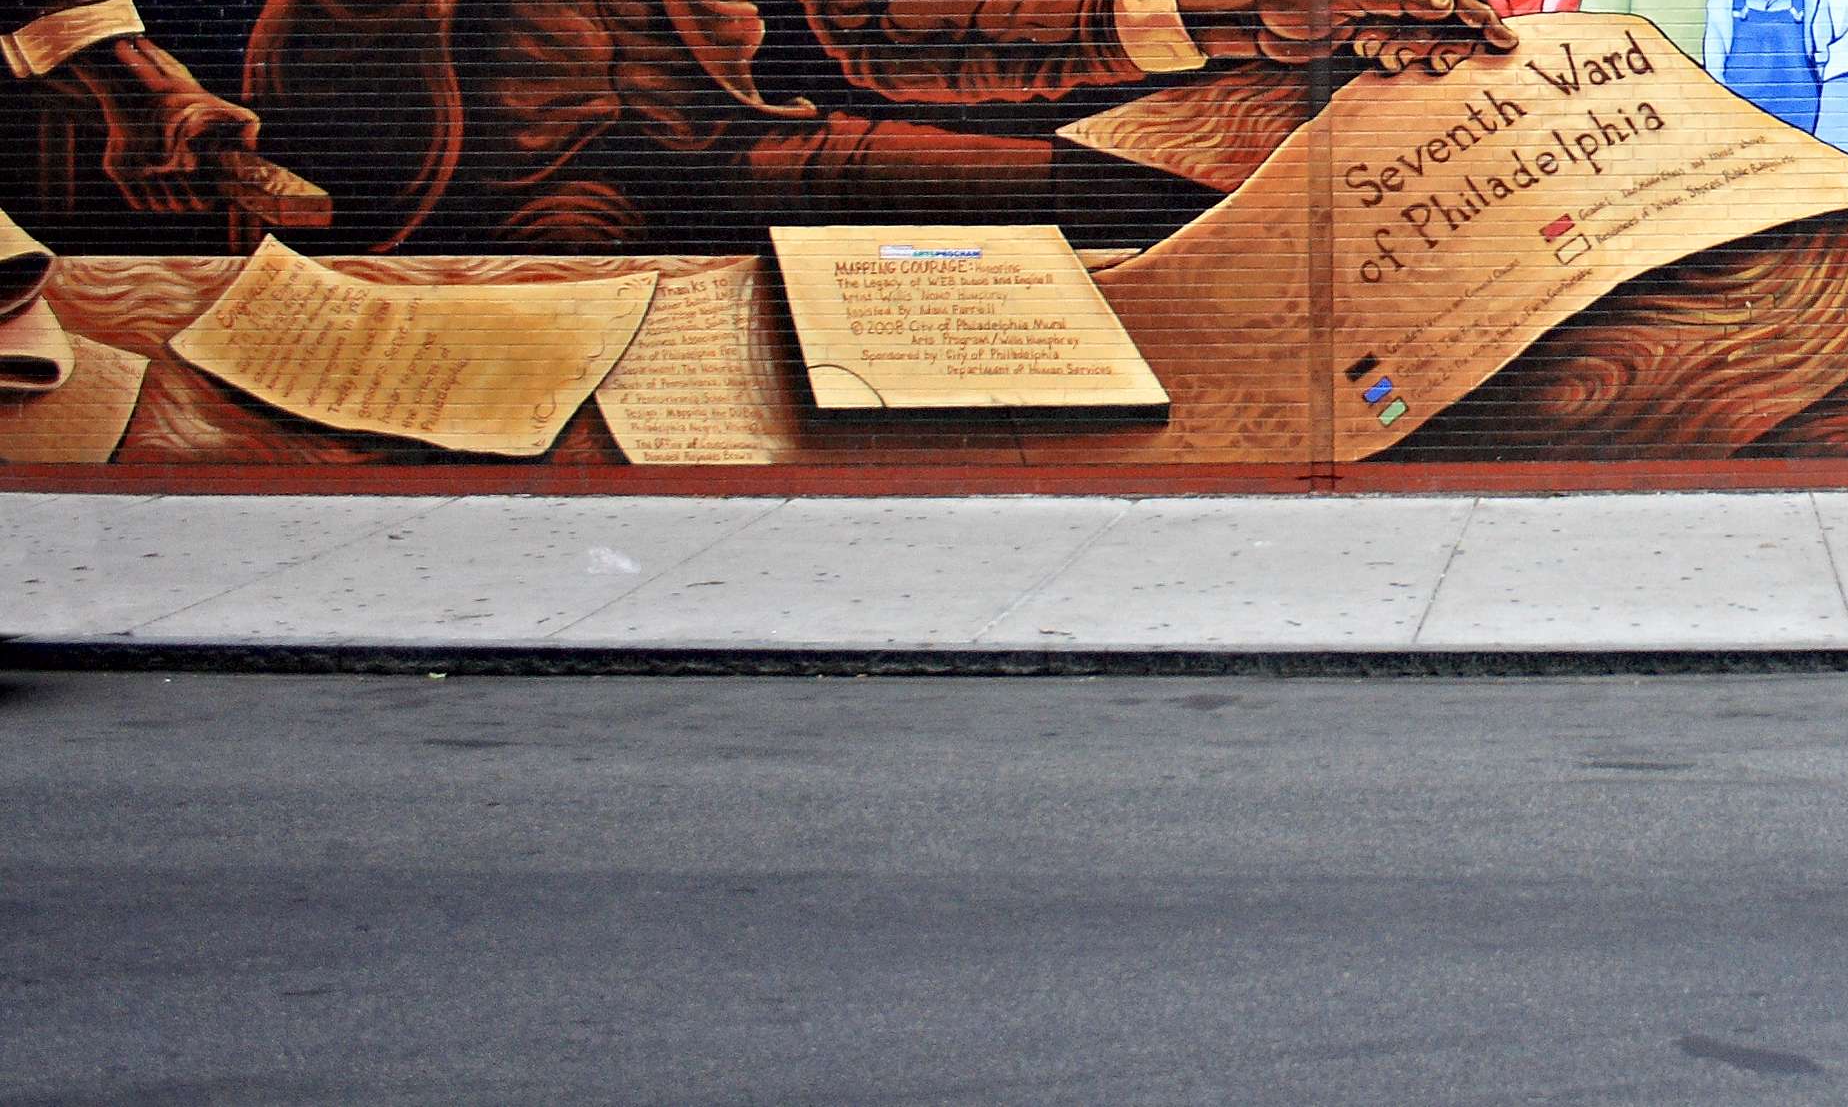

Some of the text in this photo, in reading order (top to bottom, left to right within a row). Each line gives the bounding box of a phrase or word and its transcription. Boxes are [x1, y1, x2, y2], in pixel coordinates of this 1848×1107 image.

[1345, 29, 1655, 208] Seventh Ward
[1359, 102, 1666, 284] of Philadelphia
[834, 260, 897, 276] MAPPING
[657, 279, 707, 297] Thanks
[711, 278, 729, 290] to
[836, 277, 860, 289] The
[863, 277, 902, 291] Legacy
[910, 277, 921, 287] of
[993, 276, 1012, 285] and
[866, 319, 904, 335] 2008
[938, 317, 952, 331] of
[1032, 317, 1067, 330] Mural
[328, 378, 358, 413] Today
